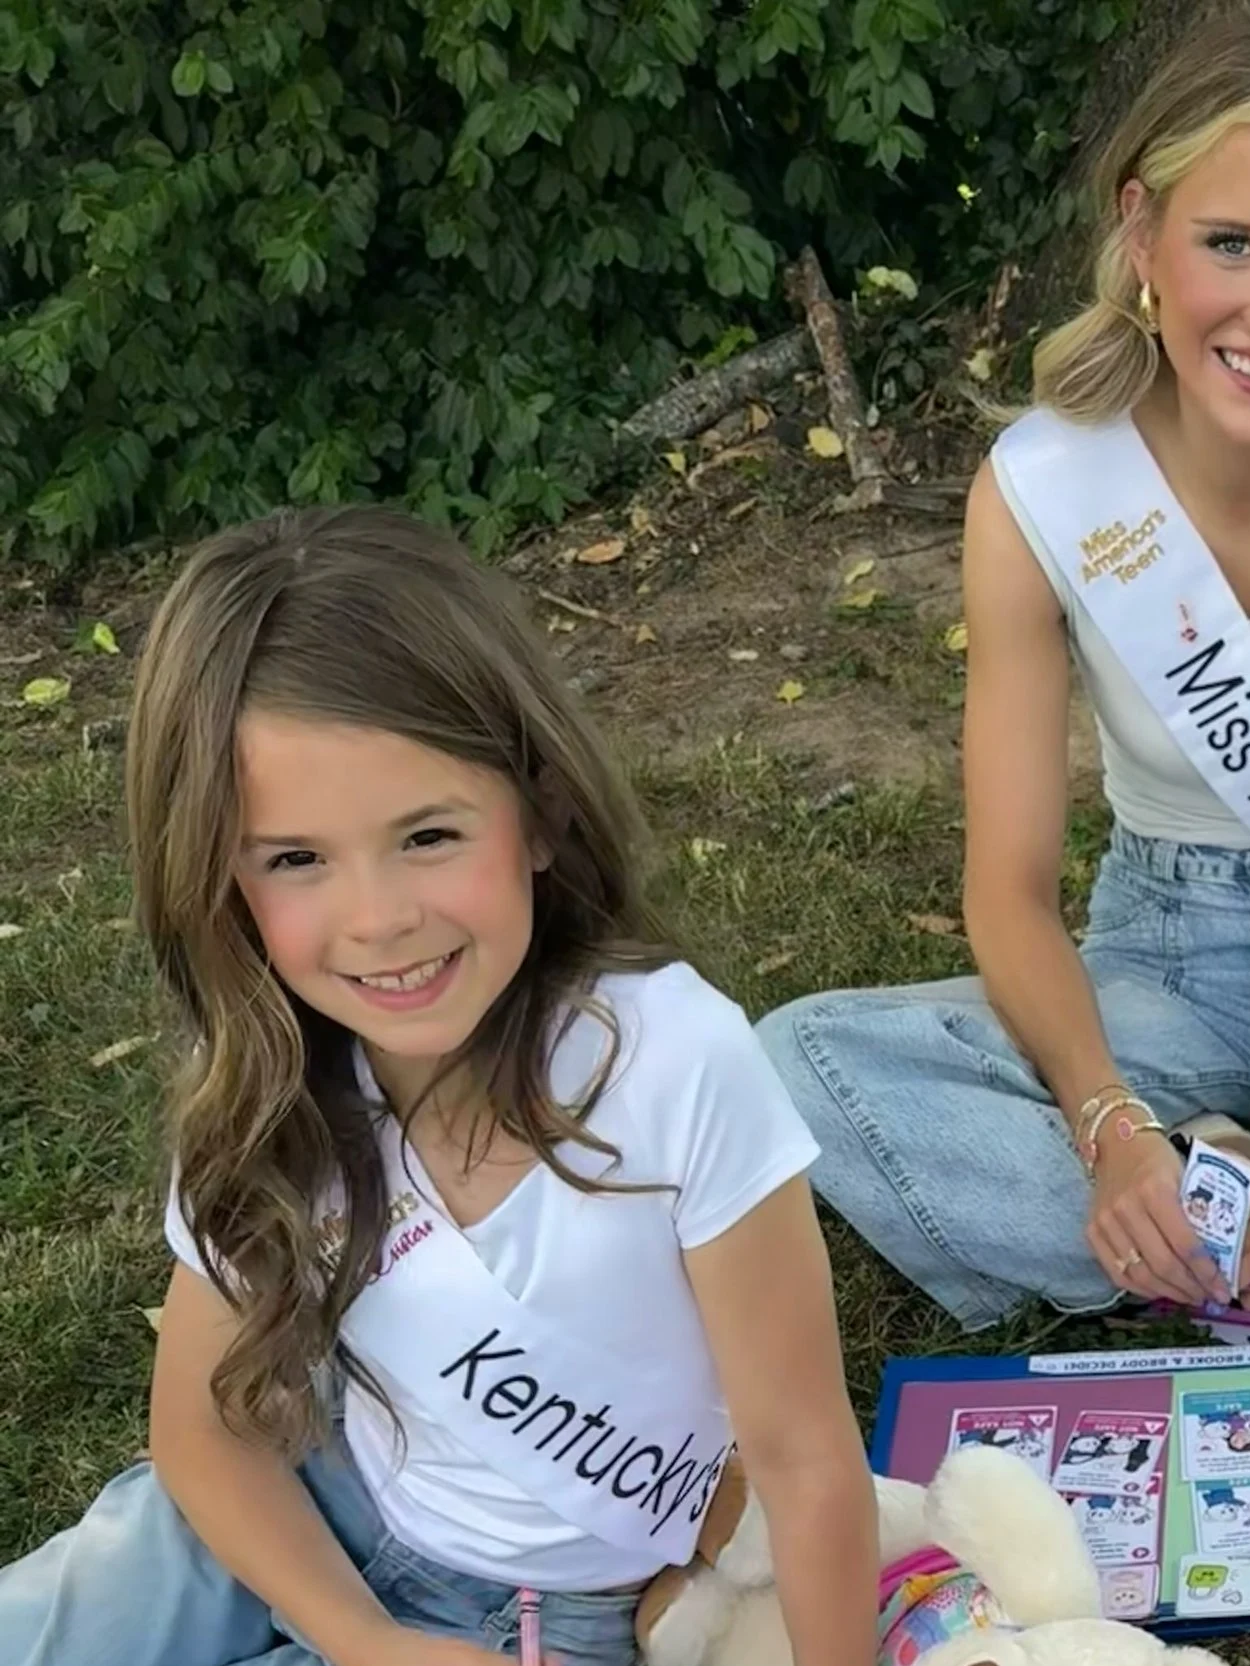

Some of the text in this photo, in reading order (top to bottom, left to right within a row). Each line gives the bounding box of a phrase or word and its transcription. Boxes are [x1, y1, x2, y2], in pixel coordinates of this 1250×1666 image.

[1079, 519, 1127, 557] Miss
[1081, 509, 1166, 584] America's
[1112, 541, 1165, 587] Teen
[1119, 1357, 1167, 1367] BRODY
[1172, 1357, 1182, 1365] &
[1188, 1354, 1244, 1365] BROOKE
